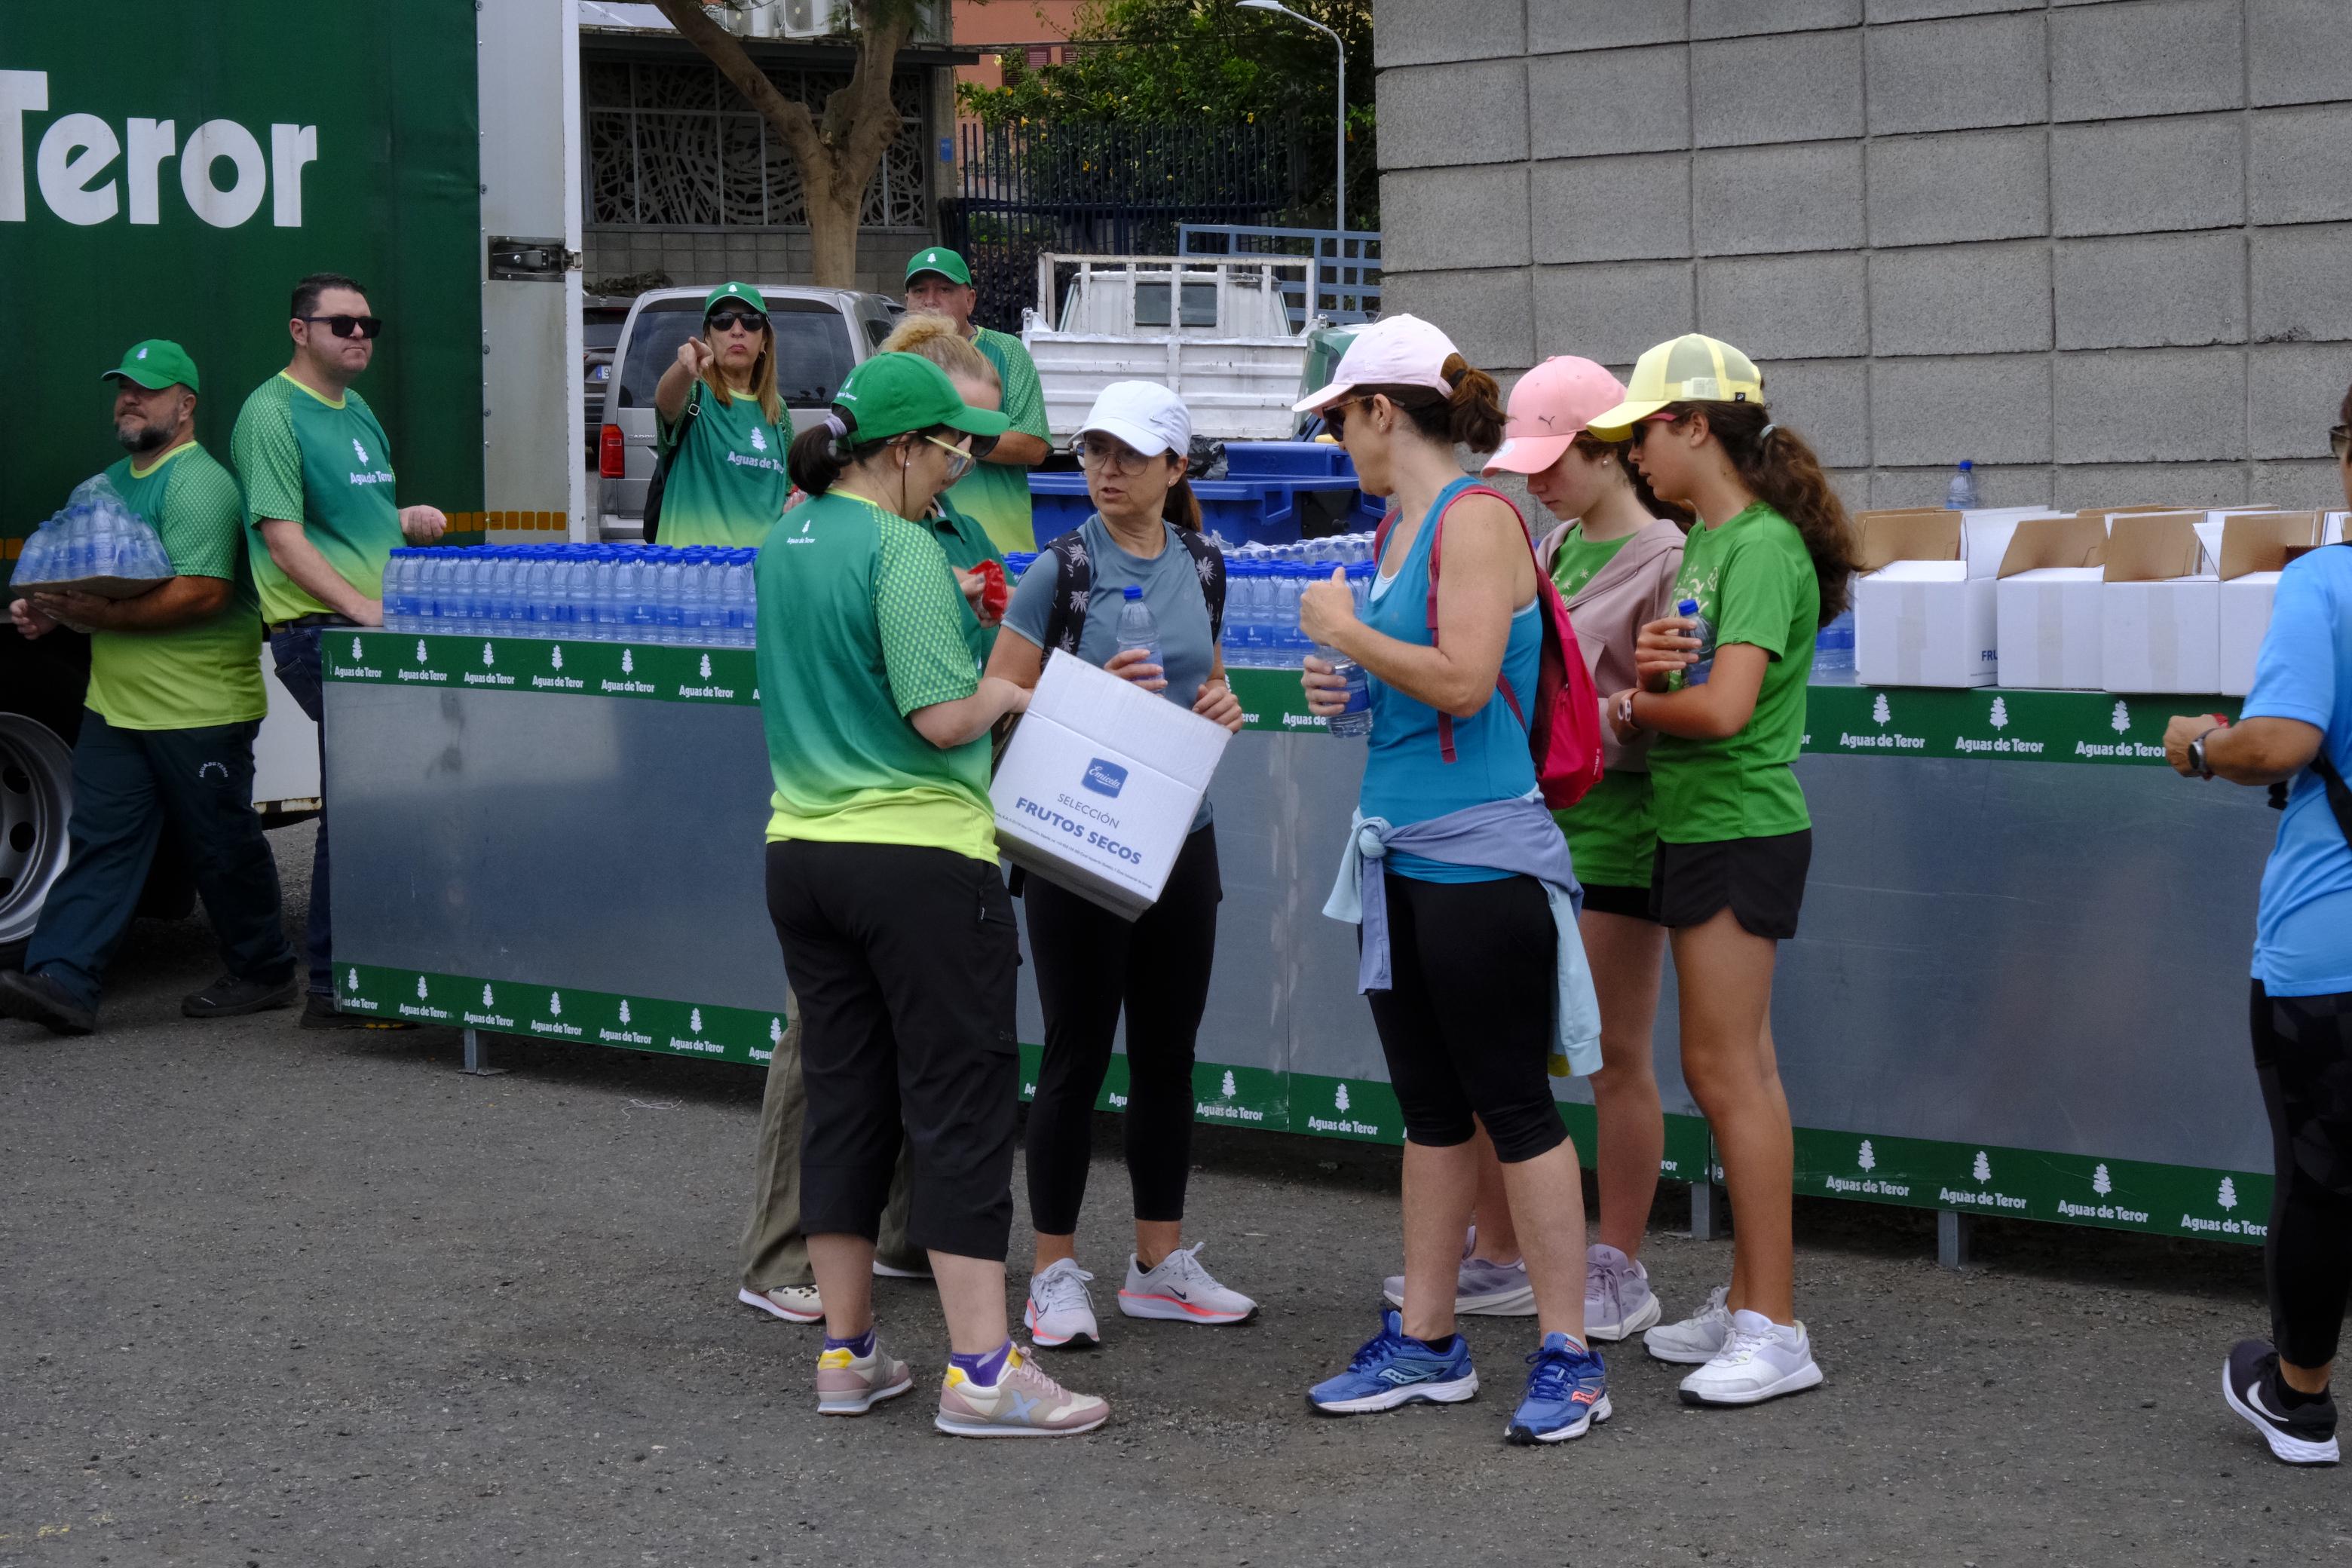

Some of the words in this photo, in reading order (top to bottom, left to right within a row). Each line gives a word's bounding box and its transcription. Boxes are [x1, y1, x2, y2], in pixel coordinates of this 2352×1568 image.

[0, 70, 317, 228] Teror
[727, 451, 758, 466] Aguas
[759, 458, 772, 469] de
[335, 665, 355, 678] Aguas
[355, 666, 365, 676] de
[364, 666, 382, 677] Teror
[398, 668, 419, 681] Aguas
[419, 669, 430, 680] de
[429, 669, 448, 681] Teror
[464, 671, 486, 684] Aguas
[486, 672, 497, 683] de
[496, 672, 515, 684] Teror
[532, 675, 555, 688] Aguas
[555, 675, 565, 687] de
[565, 676, 584, 688] Teror
[602, 678, 624, 692] Aguas
[624, 680, 635, 691] de
[635, 681, 655, 692] Teror
[679, 684, 703, 697] Aguas
[703, 685, 714, 697] de
[714, 686, 734, 698] Teror
[1242, 712, 1260, 723] eror
[1282, 712, 1312, 727] Aguas
[1312, 715, 1327, 726] de
[1840, 732, 1876, 748] Aguas
[1877, 733, 1894, 747] de
[1894, 733, 1925, 748] Teror
[1955, 736, 1993, 752] Aguas
[1994, 737, 2011, 752] de
[2012, 737, 2044, 752] Teror
[2075, 740, 2115, 758] Aguas
[2115, 742, 2133, 757] de
[1058, 792, 1120, 829] SELECCIÓN
[1015, 796, 1086, 838] FRUTOS
[1086, 831, 1142, 865] SECOS
[351, 997, 361, 1008] de
[360, 997, 378, 1010] Teror
[400, 1003, 420, 1015] Aguas
[420, 1006, 430, 1016] de
[430, 1006, 448, 1018] Teror
[464, 1011, 485, 1024] Aguas
[485, 1013, 496, 1024] de
[495, 1014, 514, 1027] Teror
[531, 1019, 553, 1032] Aguas
[553, 1021, 564, 1033] de
[563, 1023, 583, 1035] Teror
[599, 1027, 622, 1041] Aguas
[622, 1030, 633, 1042] de
[632, 1031, 652, 1044] Teror
[670, 1036, 694, 1049] Aguas
[693, 1040, 705, 1050] de
[704, 1040, 724, 1053] Teror
[1108, 1092, 1128, 1107] Agu
[1196, 1102, 1225, 1116] Aguas
[1225, 1105, 1239, 1118] de
[1239, 1106, 1263, 1120] Teror
[1308, 1116, 1338, 1131] Aguas
[1338, 1119, 1352, 1132] de
[1352, 1120, 1378, 1135] Teror
[1661, 1160, 1678, 1171] ror
[1826, 1175, 1861, 1192] Aguas
[1862, 1179, 1879, 1193] de
[1879, 1181, 1910, 1196] Teror
[1940, 1187, 1977, 1204] Aguas
[1977, 1191, 1994, 1205] de
[1995, 1193, 2027, 1208] Teror
[2058, 1199, 2096, 1217] Aguas
[2097, 1204, 2115, 1218] de
[2115, 1205, 2148, 1222] Teror
[2180, 1214, 2221, 1232] Aguas
[2222, 1218, 2240, 1233] de
[2240, 1220, 2268, 1237] Tero
